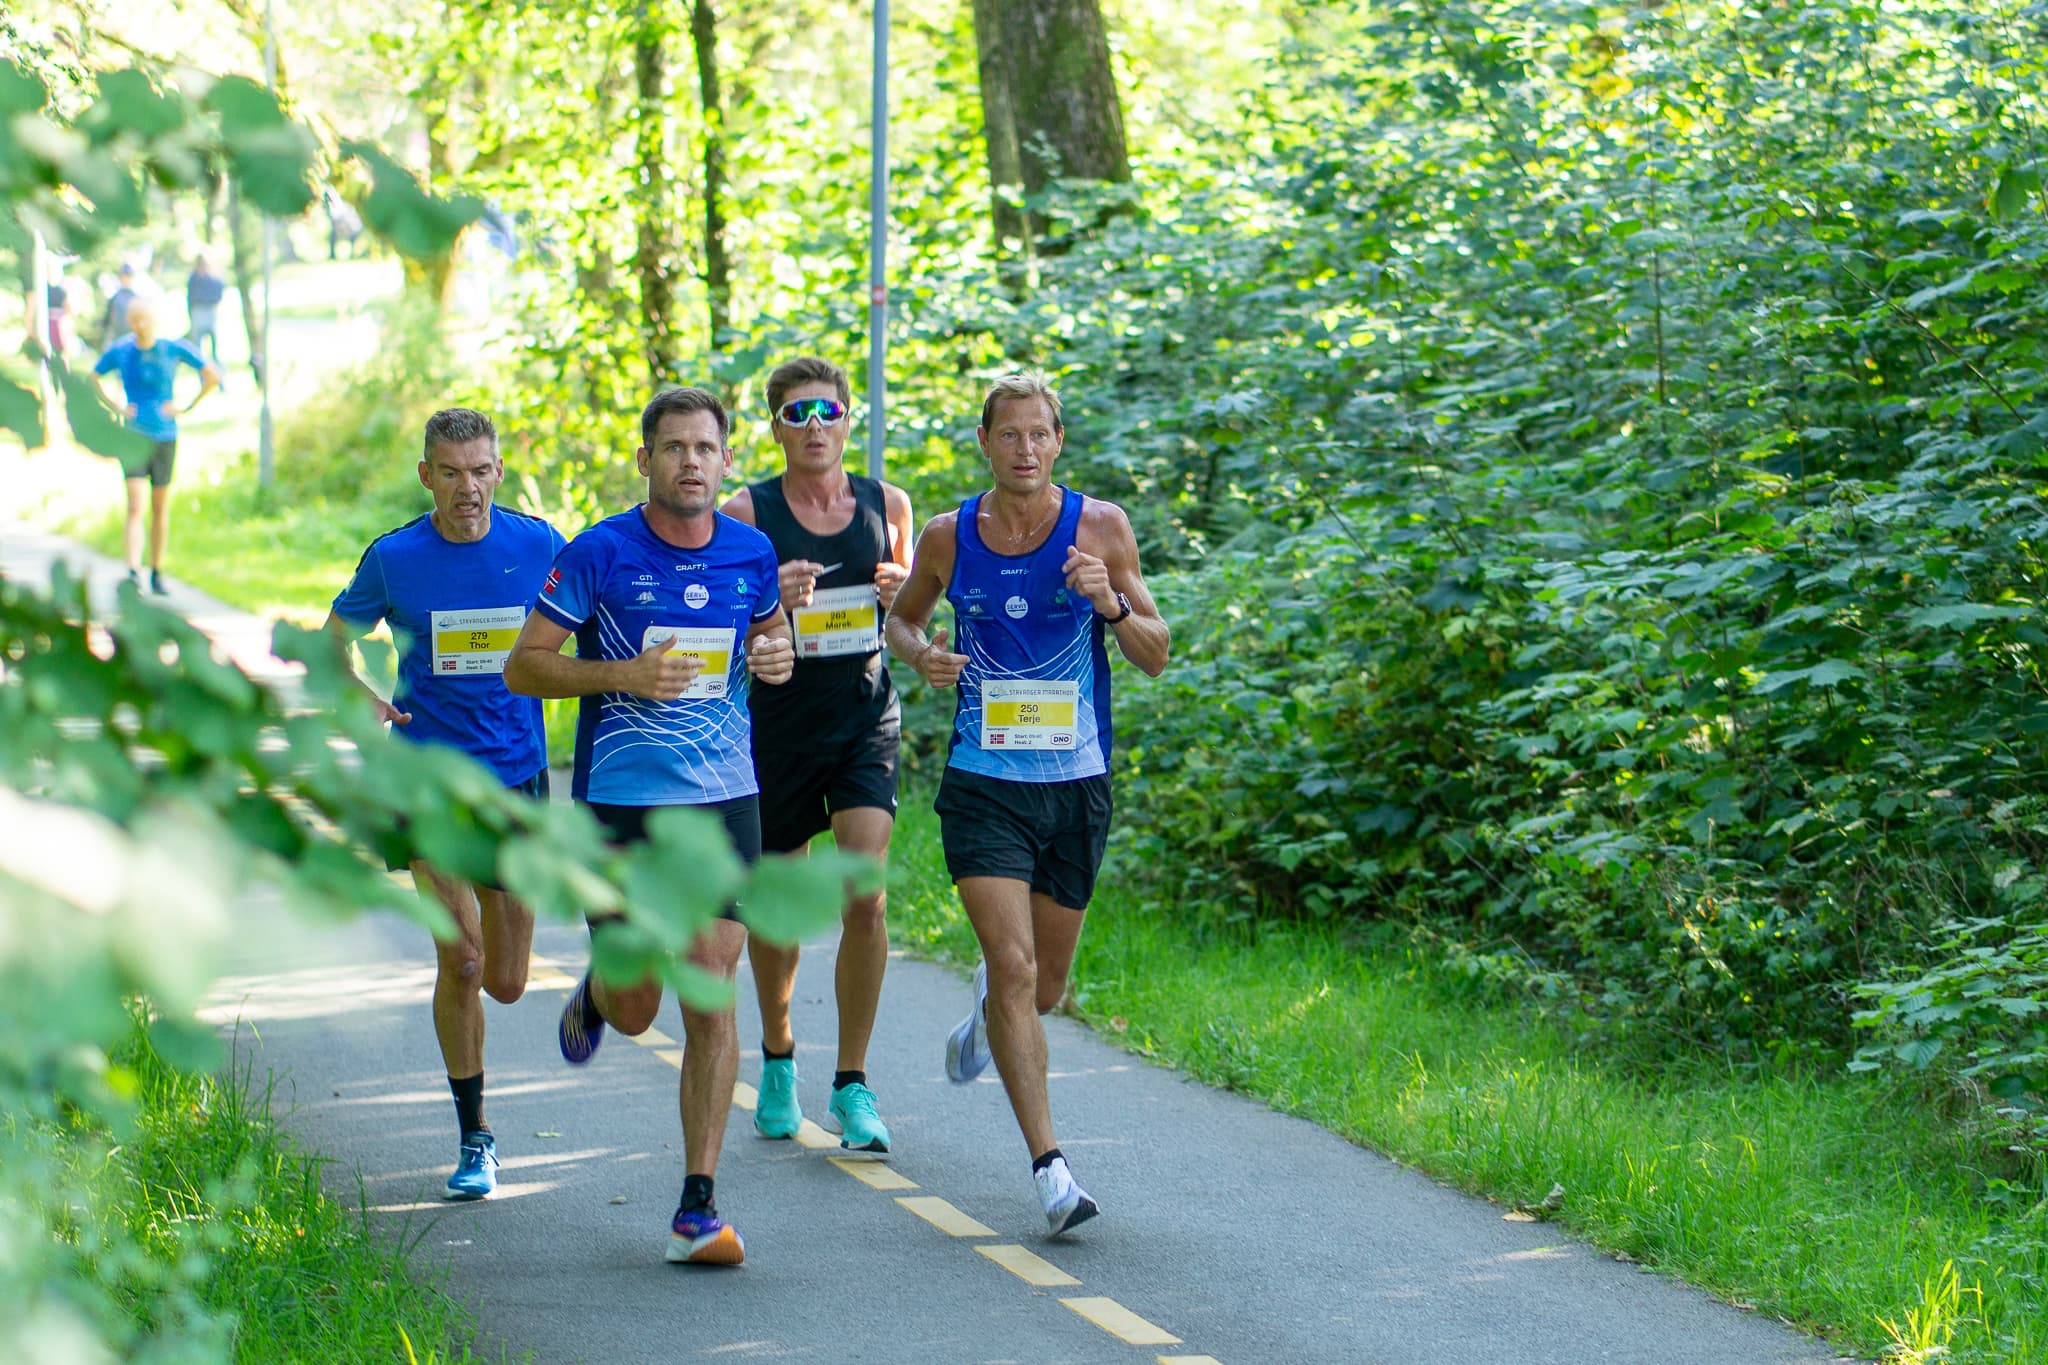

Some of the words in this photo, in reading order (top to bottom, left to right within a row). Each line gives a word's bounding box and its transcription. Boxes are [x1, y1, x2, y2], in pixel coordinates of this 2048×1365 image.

[675, 563, 702, 572] CRAFT
[470, 631, 488, 640] 279
[469, 641, 490, 650] Thor
[1020, 704, 1039, 713] 250
[1017, 714, 1041, 724] Terje
